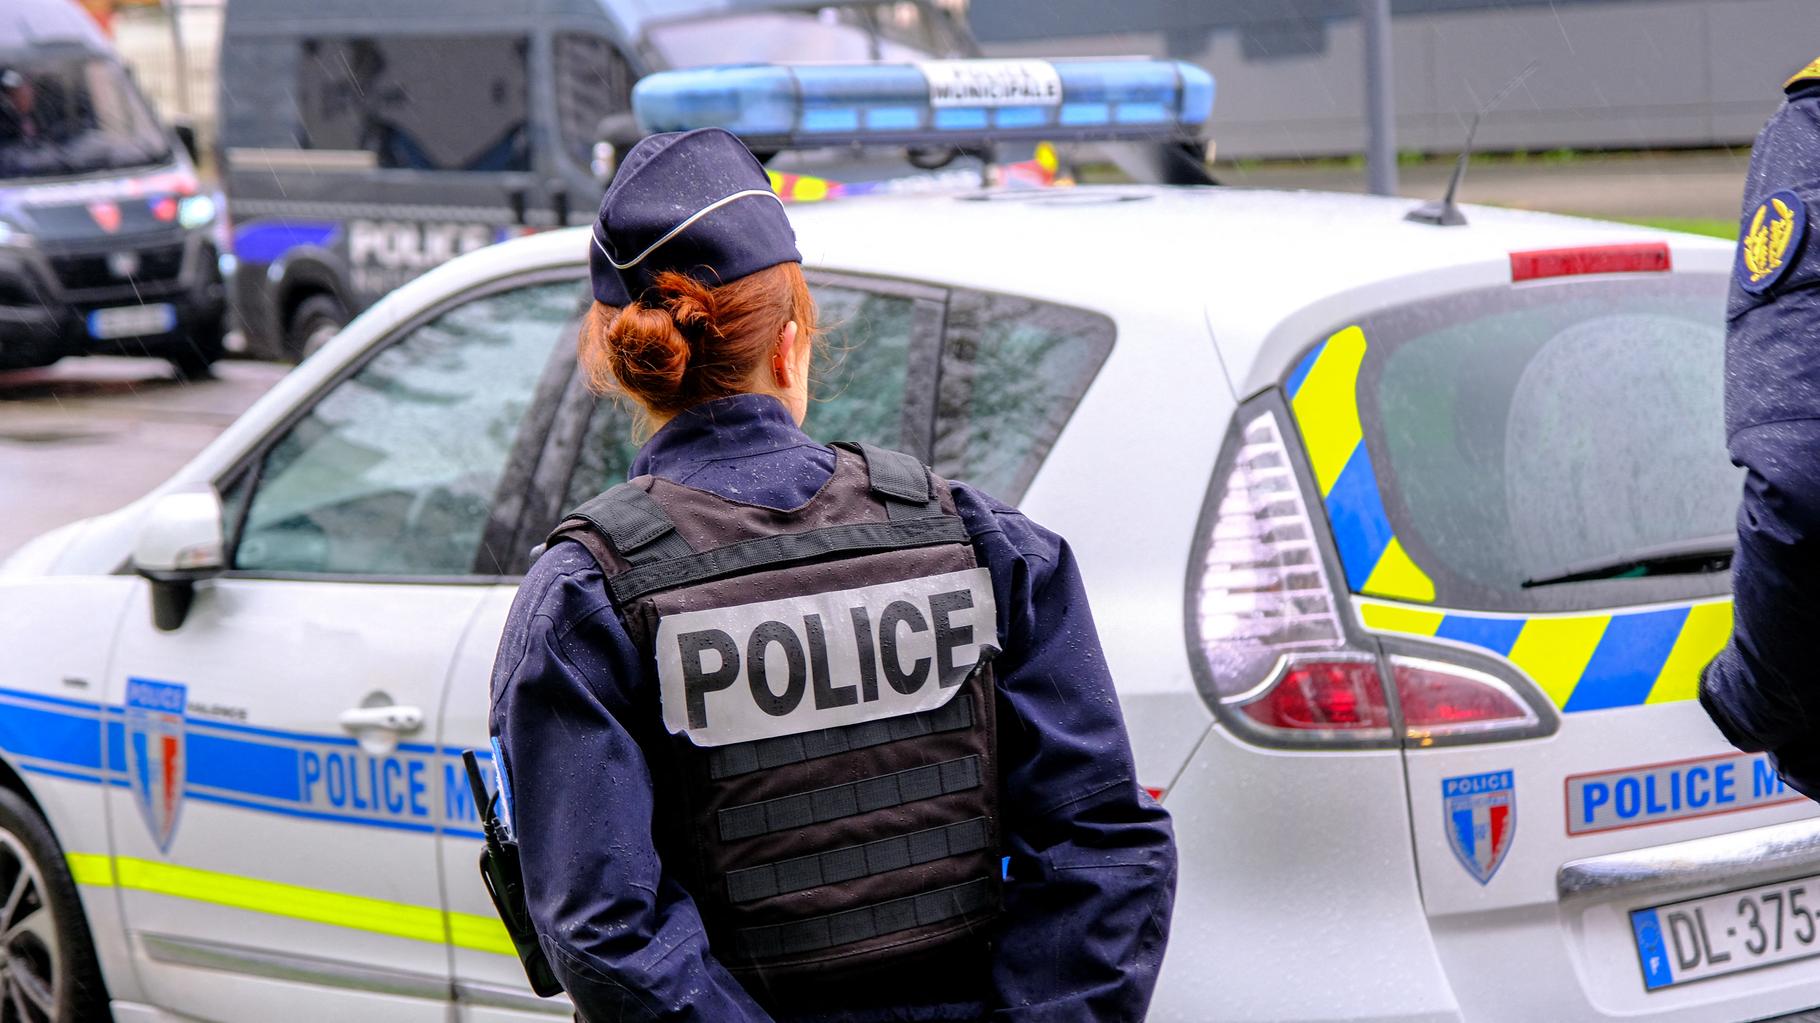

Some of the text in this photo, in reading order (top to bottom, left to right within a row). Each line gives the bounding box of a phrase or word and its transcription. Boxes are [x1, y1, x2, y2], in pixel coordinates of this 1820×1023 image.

[676, 588, 975, 731] POLICE
[302, 750, 428, 817] POLICE
[1447, 773, 1509, 795] POLICE
[1583, 762, 1736, 825] POLICE
